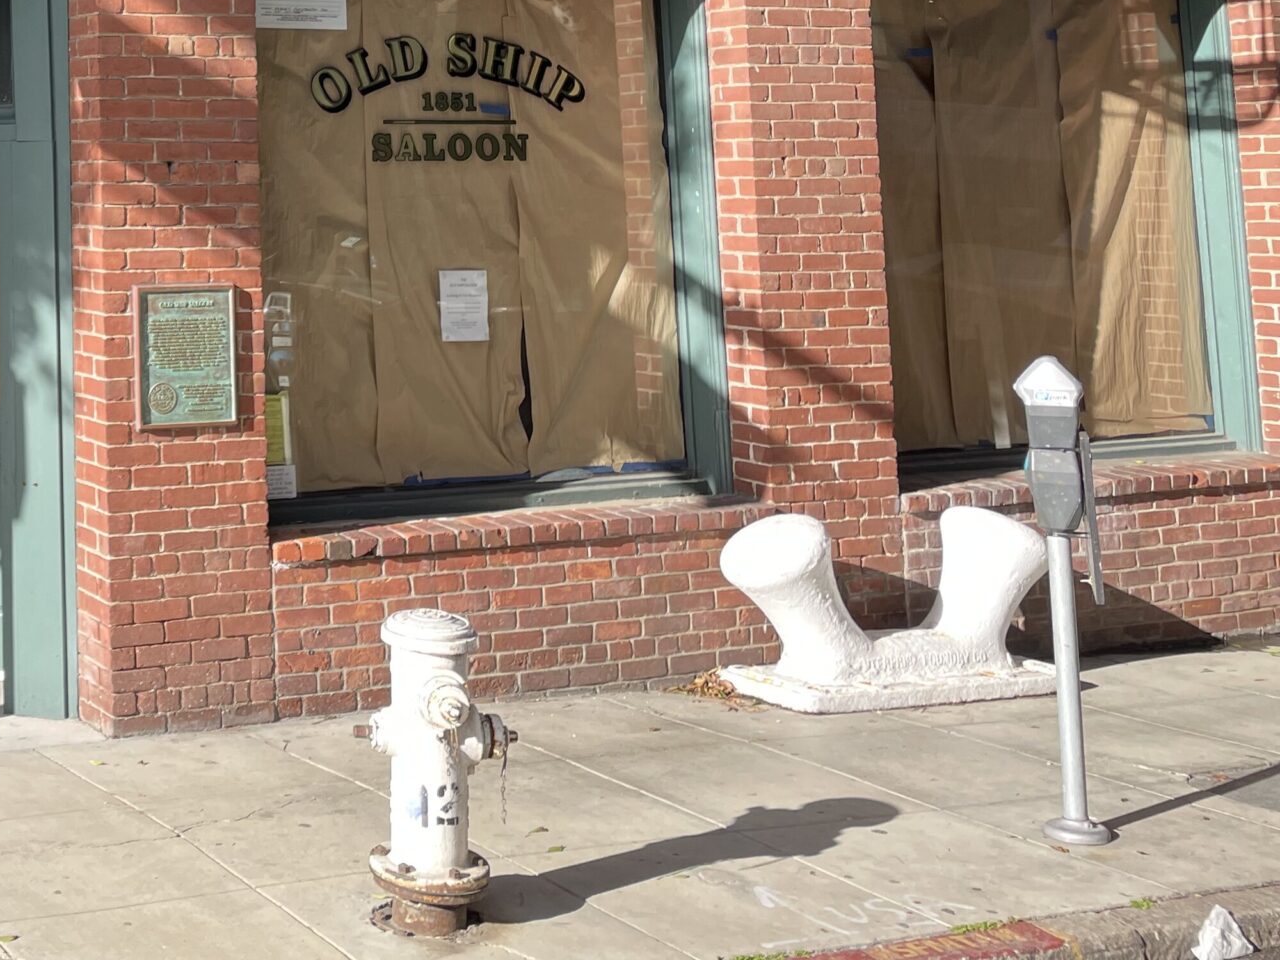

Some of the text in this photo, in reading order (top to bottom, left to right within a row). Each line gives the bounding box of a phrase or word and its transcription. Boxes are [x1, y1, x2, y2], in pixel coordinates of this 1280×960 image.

[310, 33, 586, 114] OLD SHIP
[422, 92, 477, 113] 1851
[371, 132, 529, 163] SALOON
